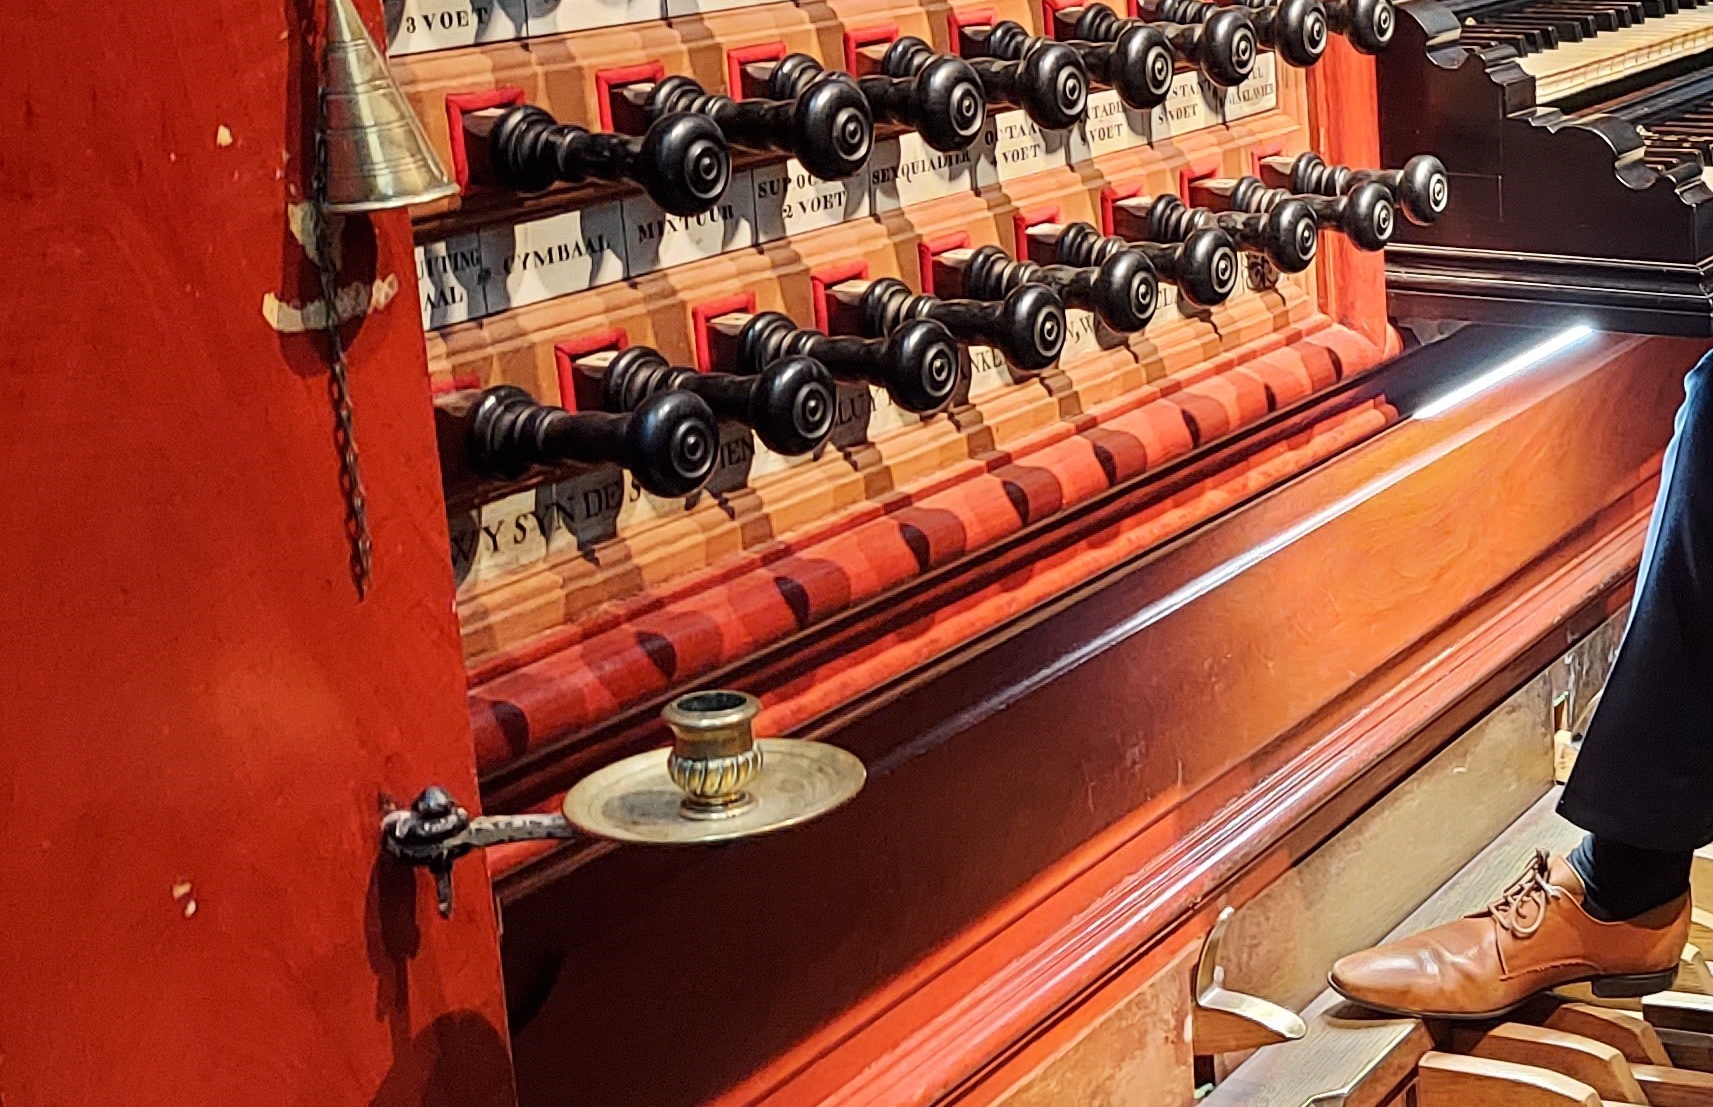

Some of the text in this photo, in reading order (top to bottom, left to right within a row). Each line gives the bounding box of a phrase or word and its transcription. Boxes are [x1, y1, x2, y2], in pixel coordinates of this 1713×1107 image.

[405, 7, 488, 34] 3 VOET
[1168, 102, 1198, 121] VOET
[1089, 123, 1123, 144] VOET
[1002, 144, 1041, 164] VOET
[782, 191, 846, 219] 2 VOET
[637, 204, 734, 243] MIXTUUR
[503, 234, 610, 274] CYMBAAL
